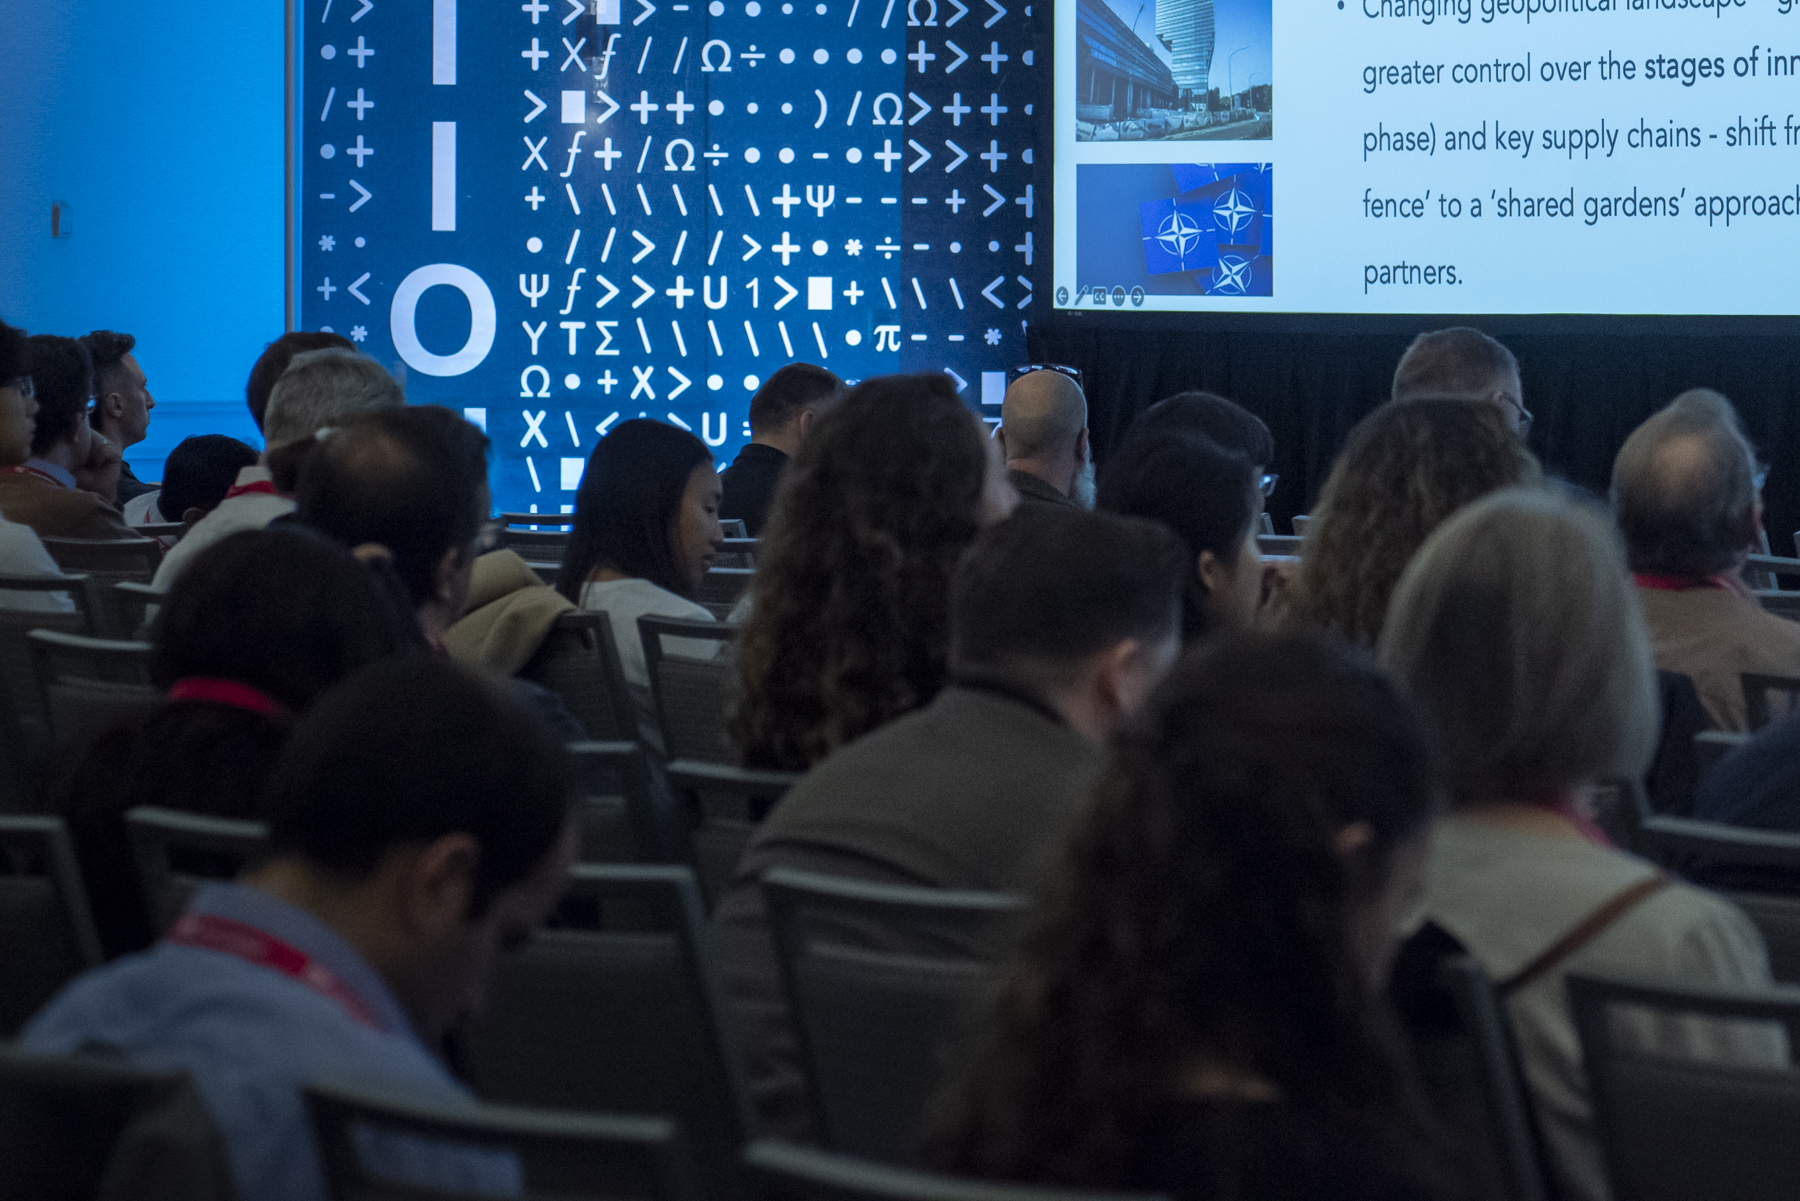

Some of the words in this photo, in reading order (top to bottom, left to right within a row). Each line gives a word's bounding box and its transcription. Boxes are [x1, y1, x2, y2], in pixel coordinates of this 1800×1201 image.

[1362, 60, 1445, 95] greater
[1451, 51, 1531, 84] control
[1540, 60, 1592, 83] over
[1597, 49, 1637, 81] the
[1644, 53, 1726, 88] stages
[1733, 44, 1760, 78] of
[1363, 121, 1436, 163] phase)
[1444, 119, 1487, 152] and
[1495, 119, 1535, 159] key
[1541, 117, 1620, 160] supply
[1627, 117, 1702, 149] chains
[1725, 114, 1777, 148] shift
[1437, 193, 1462, 219] to
[1470, 197, 1482, 219] a
[1364, 260, 1463, 295] partners.
